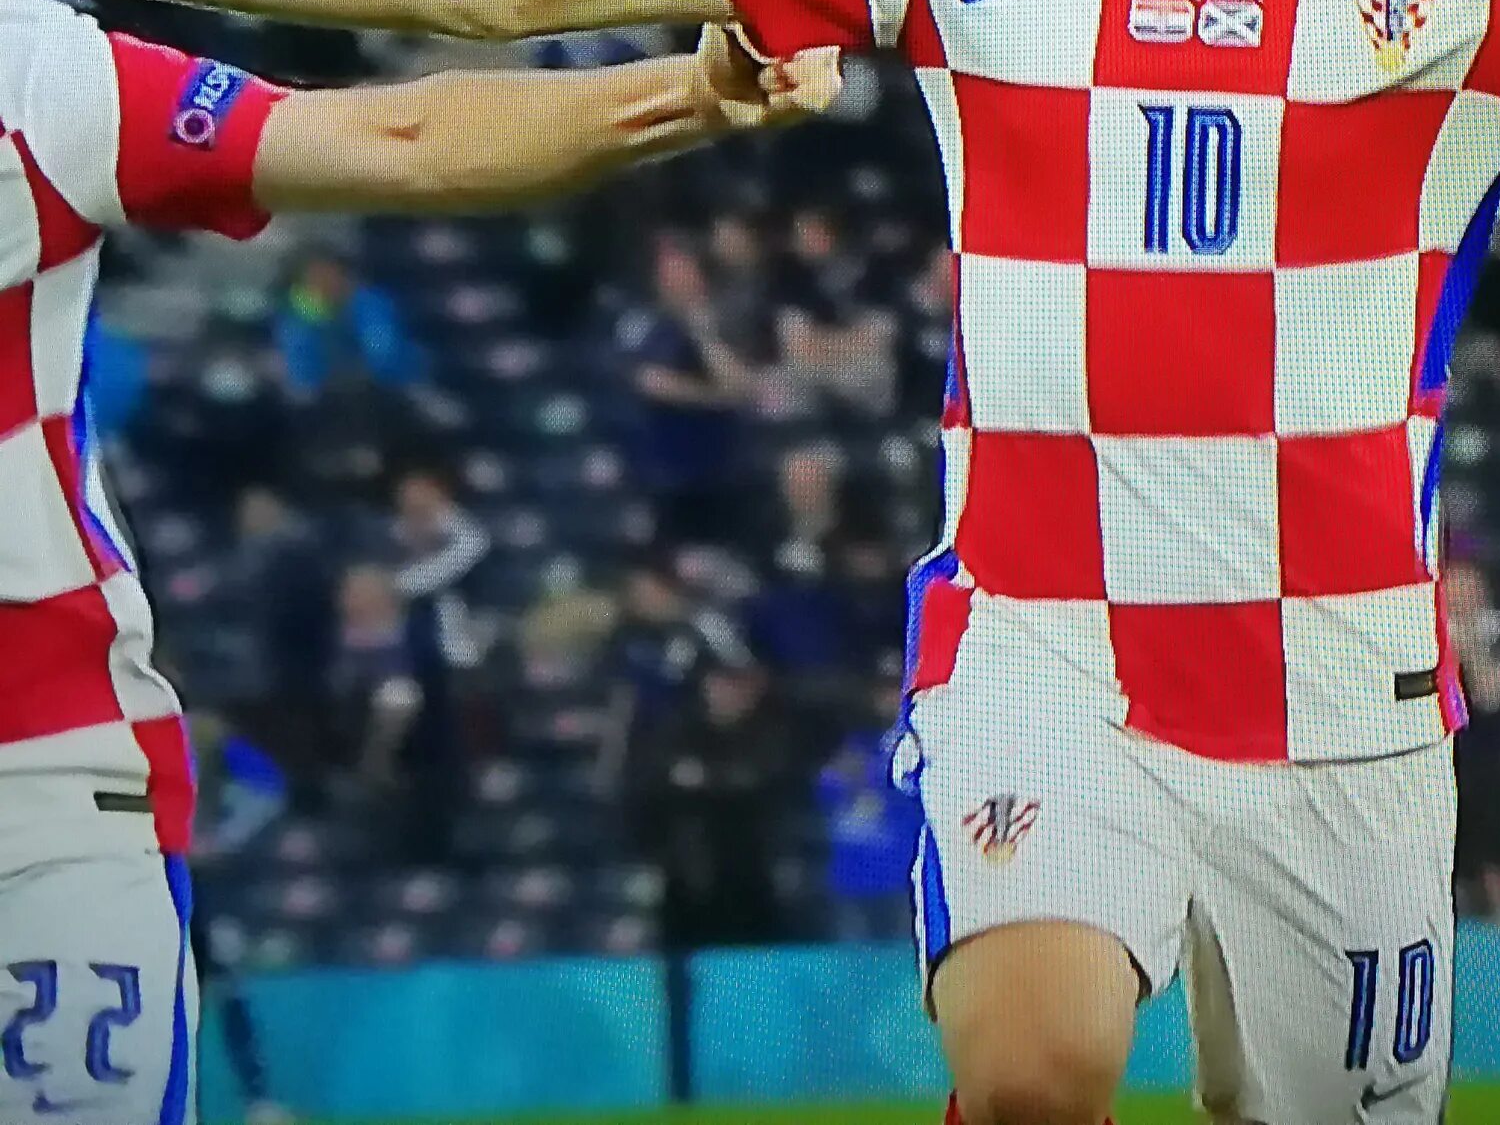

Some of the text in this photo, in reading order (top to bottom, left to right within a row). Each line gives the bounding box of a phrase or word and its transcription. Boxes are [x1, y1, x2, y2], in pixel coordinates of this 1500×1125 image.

[1137, 104, 1241, 255] 10
[0, 960, 142, 1083] 22
[1345, 938, 1434, 1071] 10
